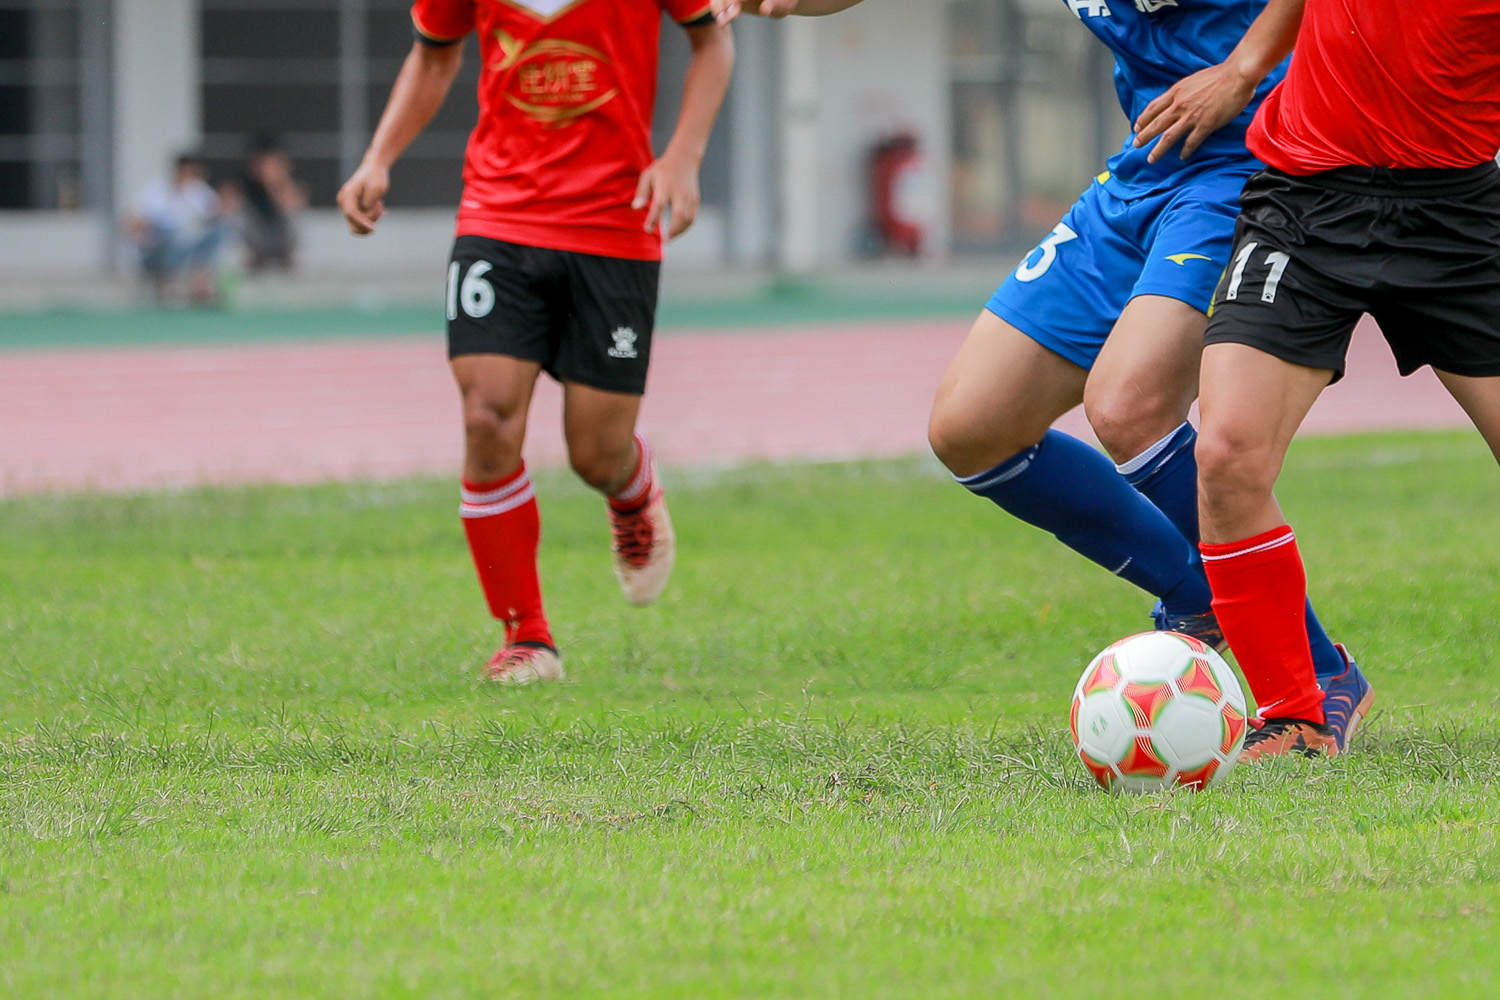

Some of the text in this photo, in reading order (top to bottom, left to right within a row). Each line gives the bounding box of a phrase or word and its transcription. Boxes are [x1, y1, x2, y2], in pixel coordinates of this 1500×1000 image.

[1015, 221, 1079, 283] 3
[1226, 242, 1290, 304] 11
[447, 259, 496, 321] 16
